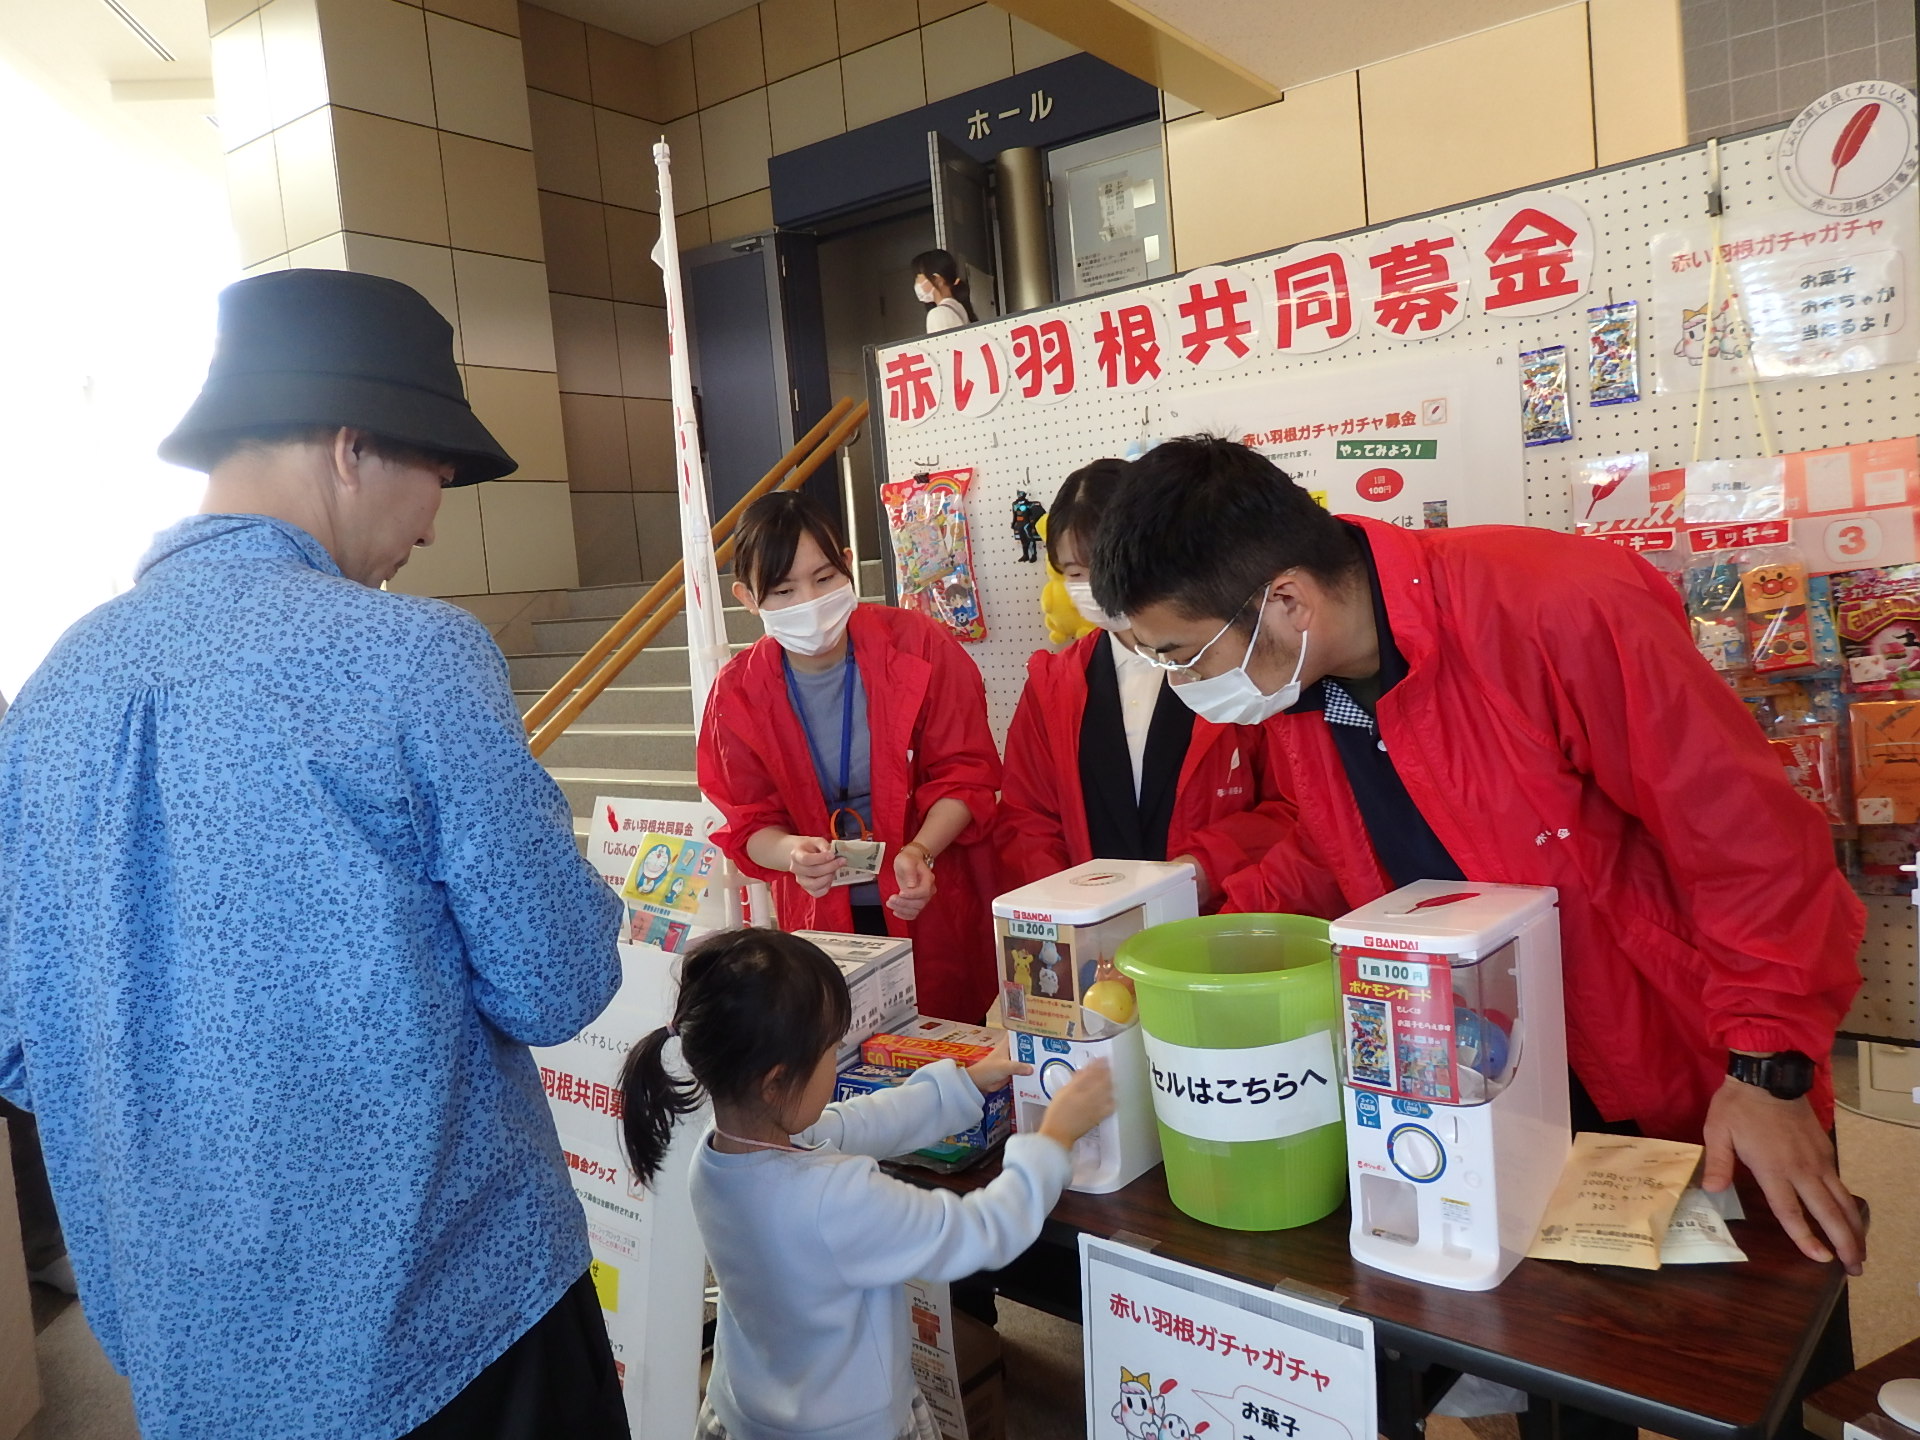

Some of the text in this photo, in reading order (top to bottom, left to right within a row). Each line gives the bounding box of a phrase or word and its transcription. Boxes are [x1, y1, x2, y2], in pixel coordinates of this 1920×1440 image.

[967, 90, 1053, 140] ホール
[1672, 218, 1884, 273] 赤い羽根ガチャガチャ
[1800, 266, 1856, 289] お菓子
[884, 206, 1580, 422] 赤い羽根共同募金
[1243, 411, 1417, 448] 赤い羽根ガチャガチャ募金
[1701, 526, 1780, 549] ラッキー
[1838, 526, 1868, 556] 3
[622, 818, 694, 837] 赤い羽根共同募金
[1021, 911, 1052, 923] BANDAI
[1375, 937, 1419, 951] BANDAI
[1348, 980, 1432, 1002] ポケモンカード
[1152, 1061, 1328, 1105] セルはこちらへ
[1109, 1293, 1331, 1393] 赤い羽根ガチャガチャ
[1242, 1401, 1300, 1438] お菓子
